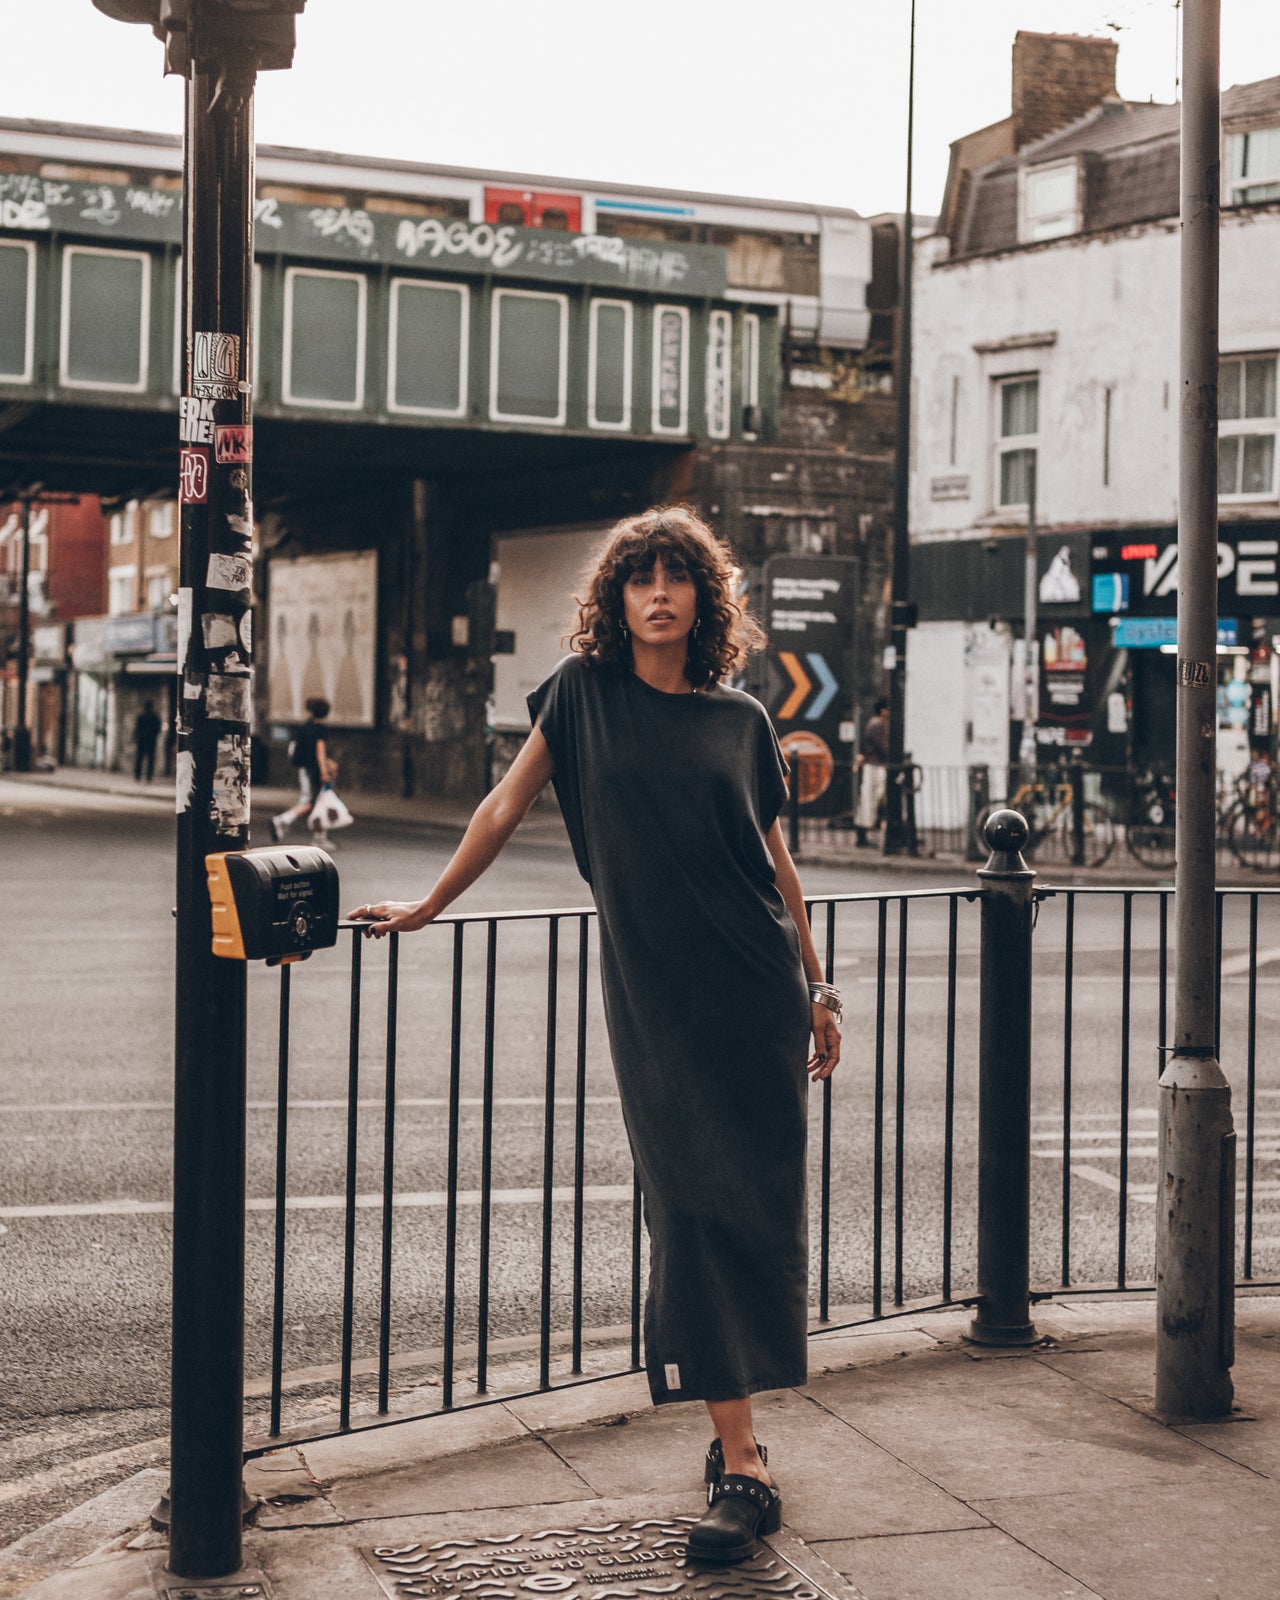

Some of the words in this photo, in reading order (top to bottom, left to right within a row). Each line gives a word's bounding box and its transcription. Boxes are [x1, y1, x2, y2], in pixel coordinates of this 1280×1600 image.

[430, 1564, 537, 1584] RAPIDE
[550, 1559, 585, 1571] 40
[584, 1566, 656, 1579] TRANSPORT
[588, 1577, 614, 1585] FOR
[618, 1570, 672, 1582] LONDON
